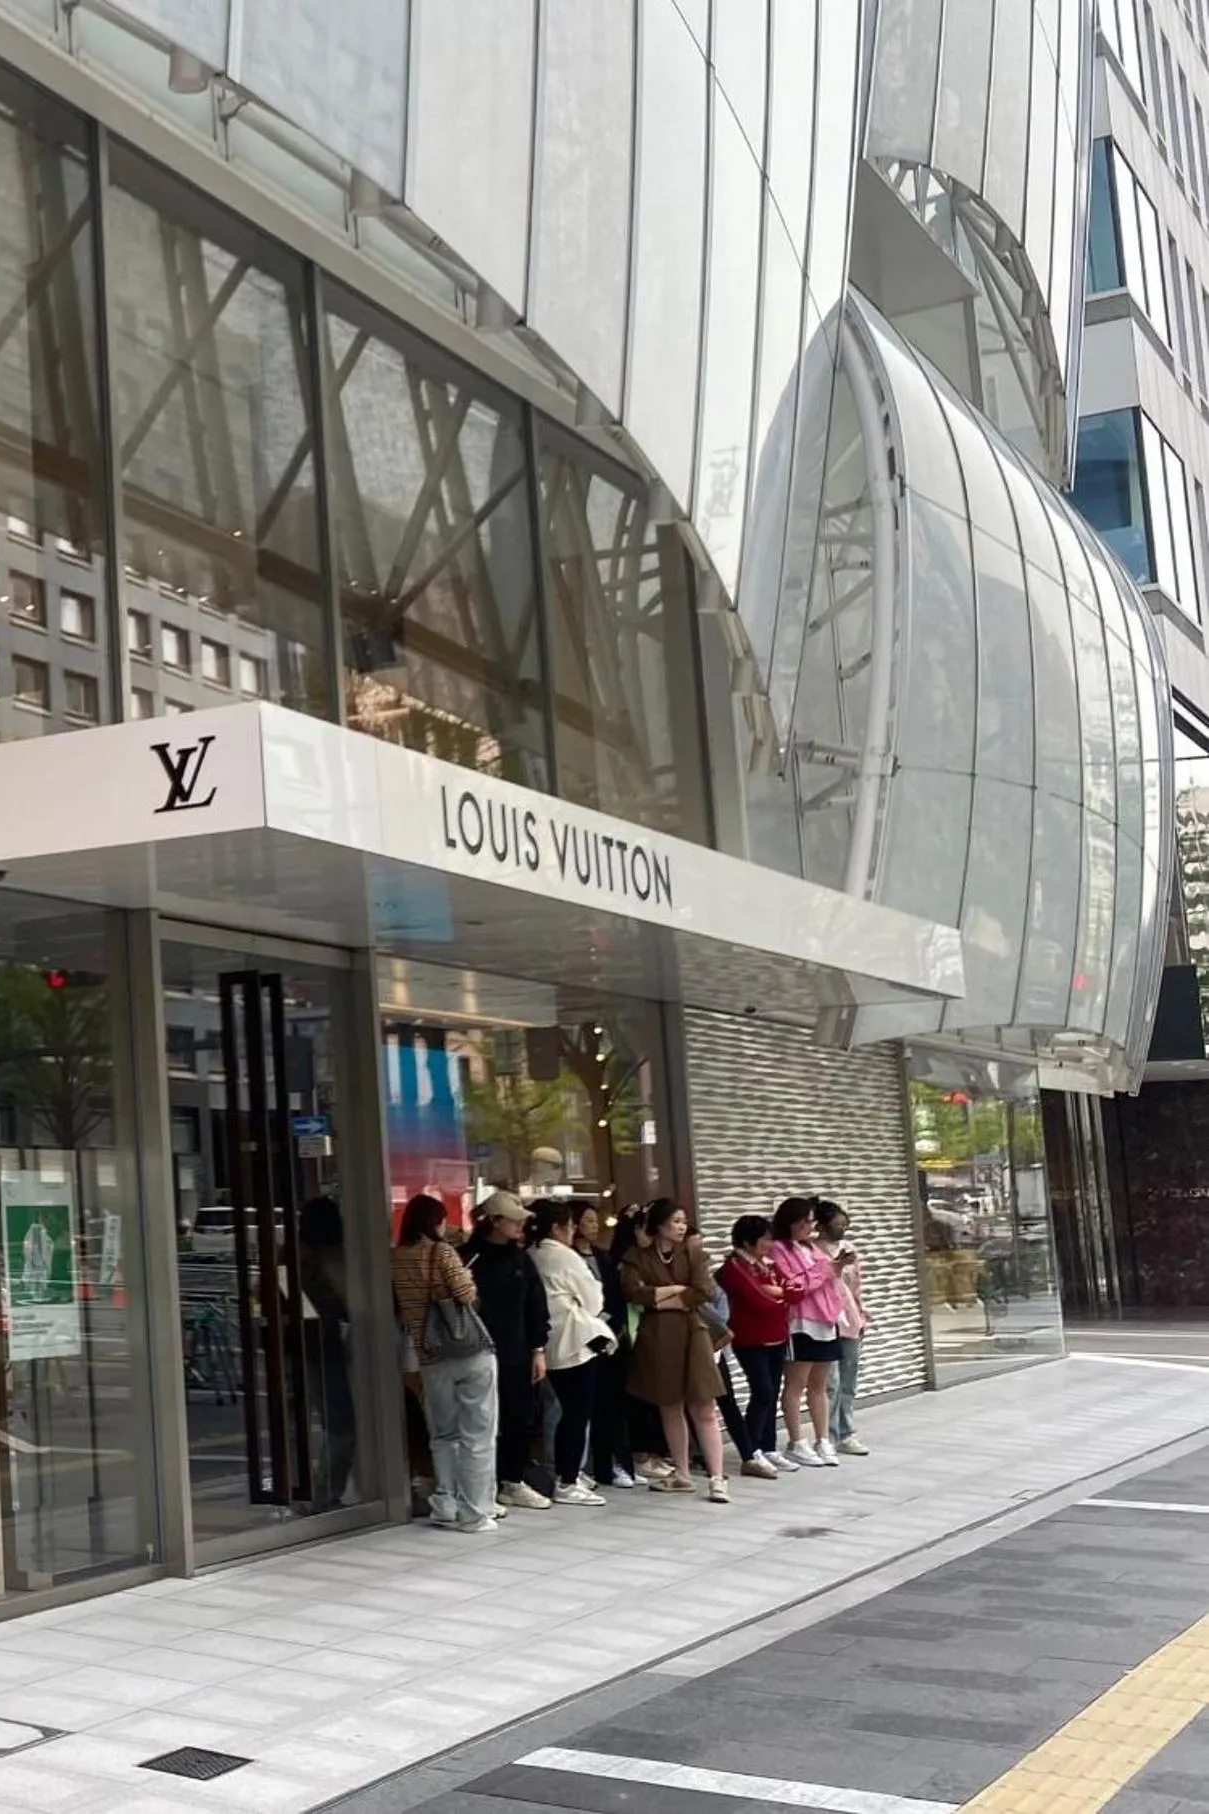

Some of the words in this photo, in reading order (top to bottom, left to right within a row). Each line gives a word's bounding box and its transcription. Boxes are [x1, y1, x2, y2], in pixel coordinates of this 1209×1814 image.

[150, 735, 217, 813] LV
[441, 785, 539, 871] LOUIS
[550, 819, 673, 908] VUITTON
